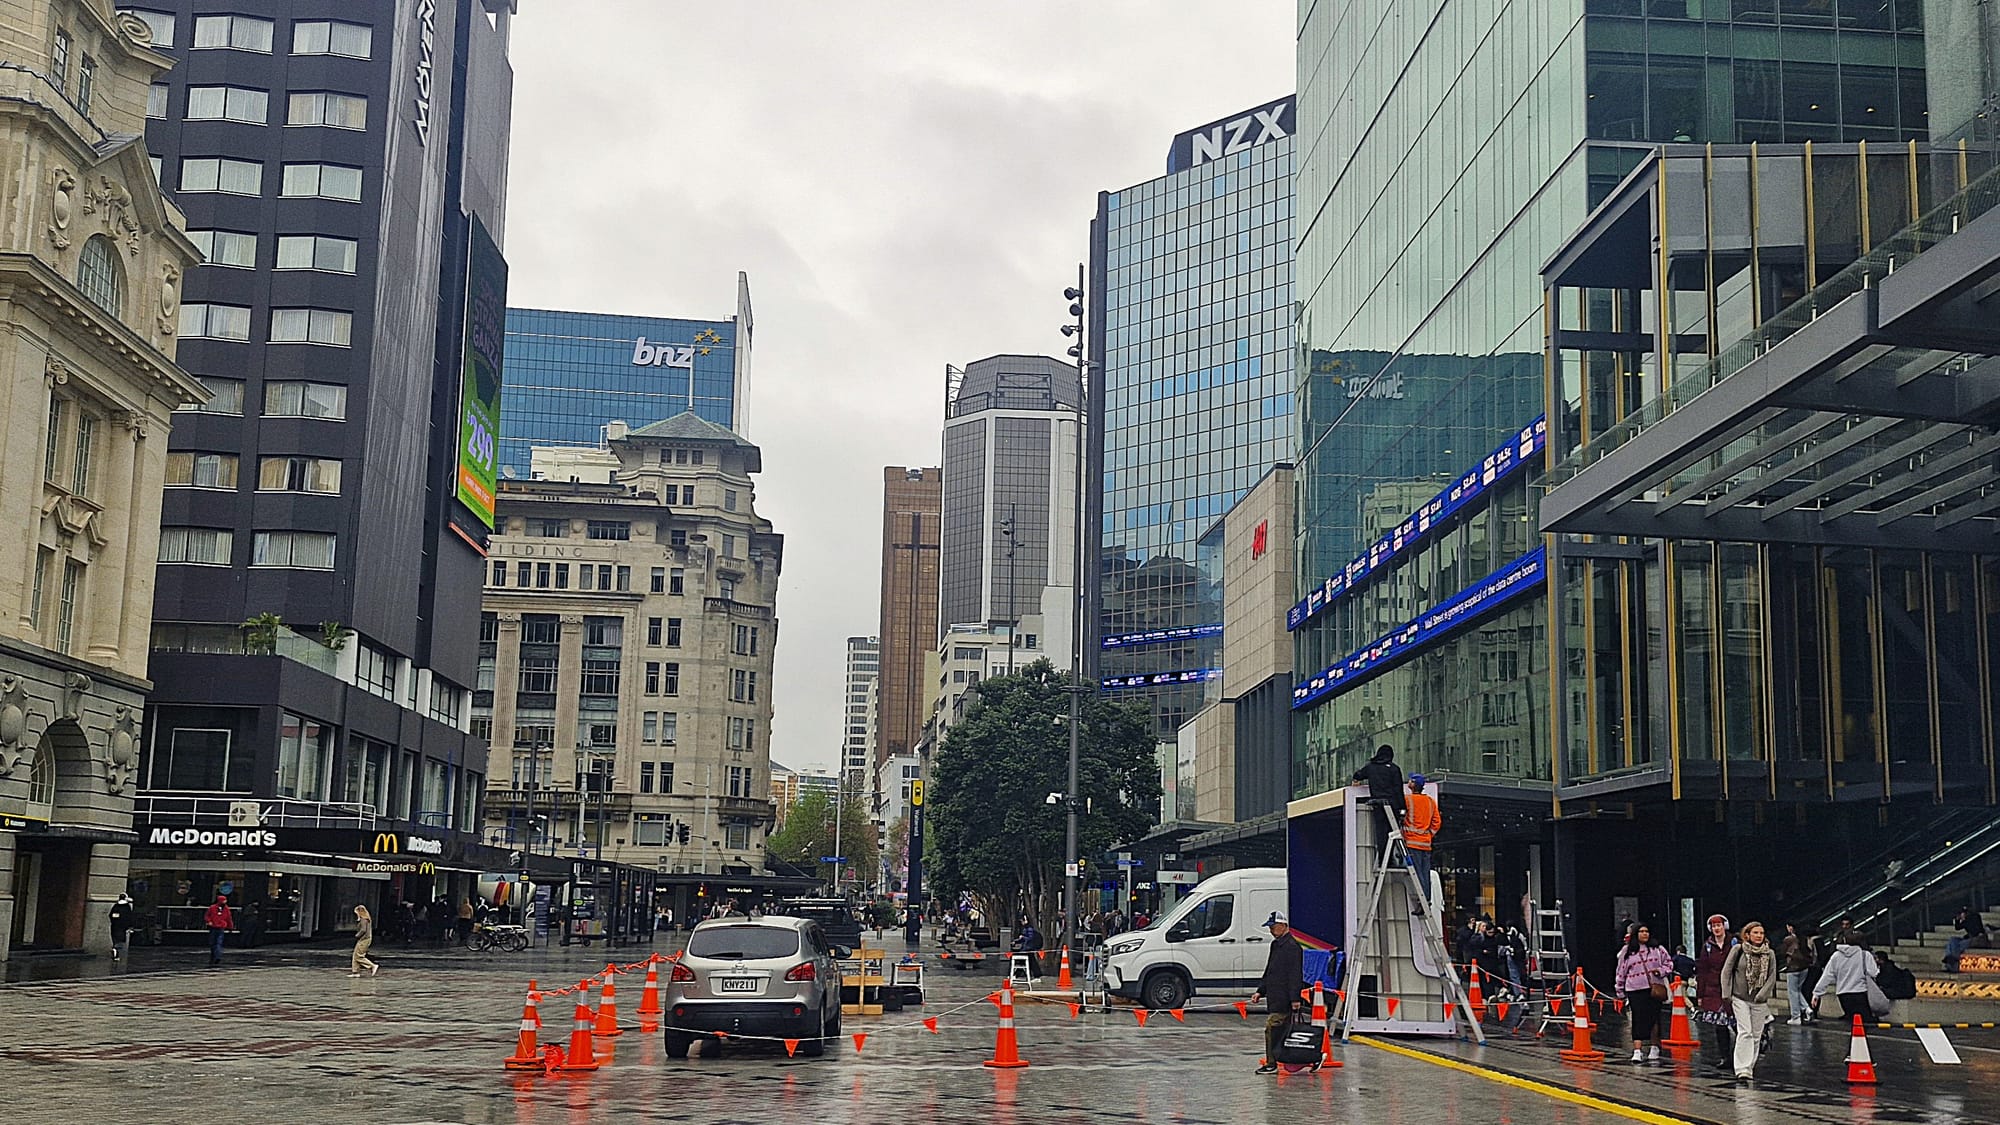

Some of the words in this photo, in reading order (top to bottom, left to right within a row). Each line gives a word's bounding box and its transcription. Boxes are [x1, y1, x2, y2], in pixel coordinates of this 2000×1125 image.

[414, 0, 435, 148] MÖVEN
[1191, 102, 1288, 168] NZX
[631, 336, 695, 369] bnz
[498, 543, 583, 558] ILDING
[1487, 583, 1496, 596] the
[149, 828, 277, 846] McDonald's
[356, 863, 416, 872] McDonald's
